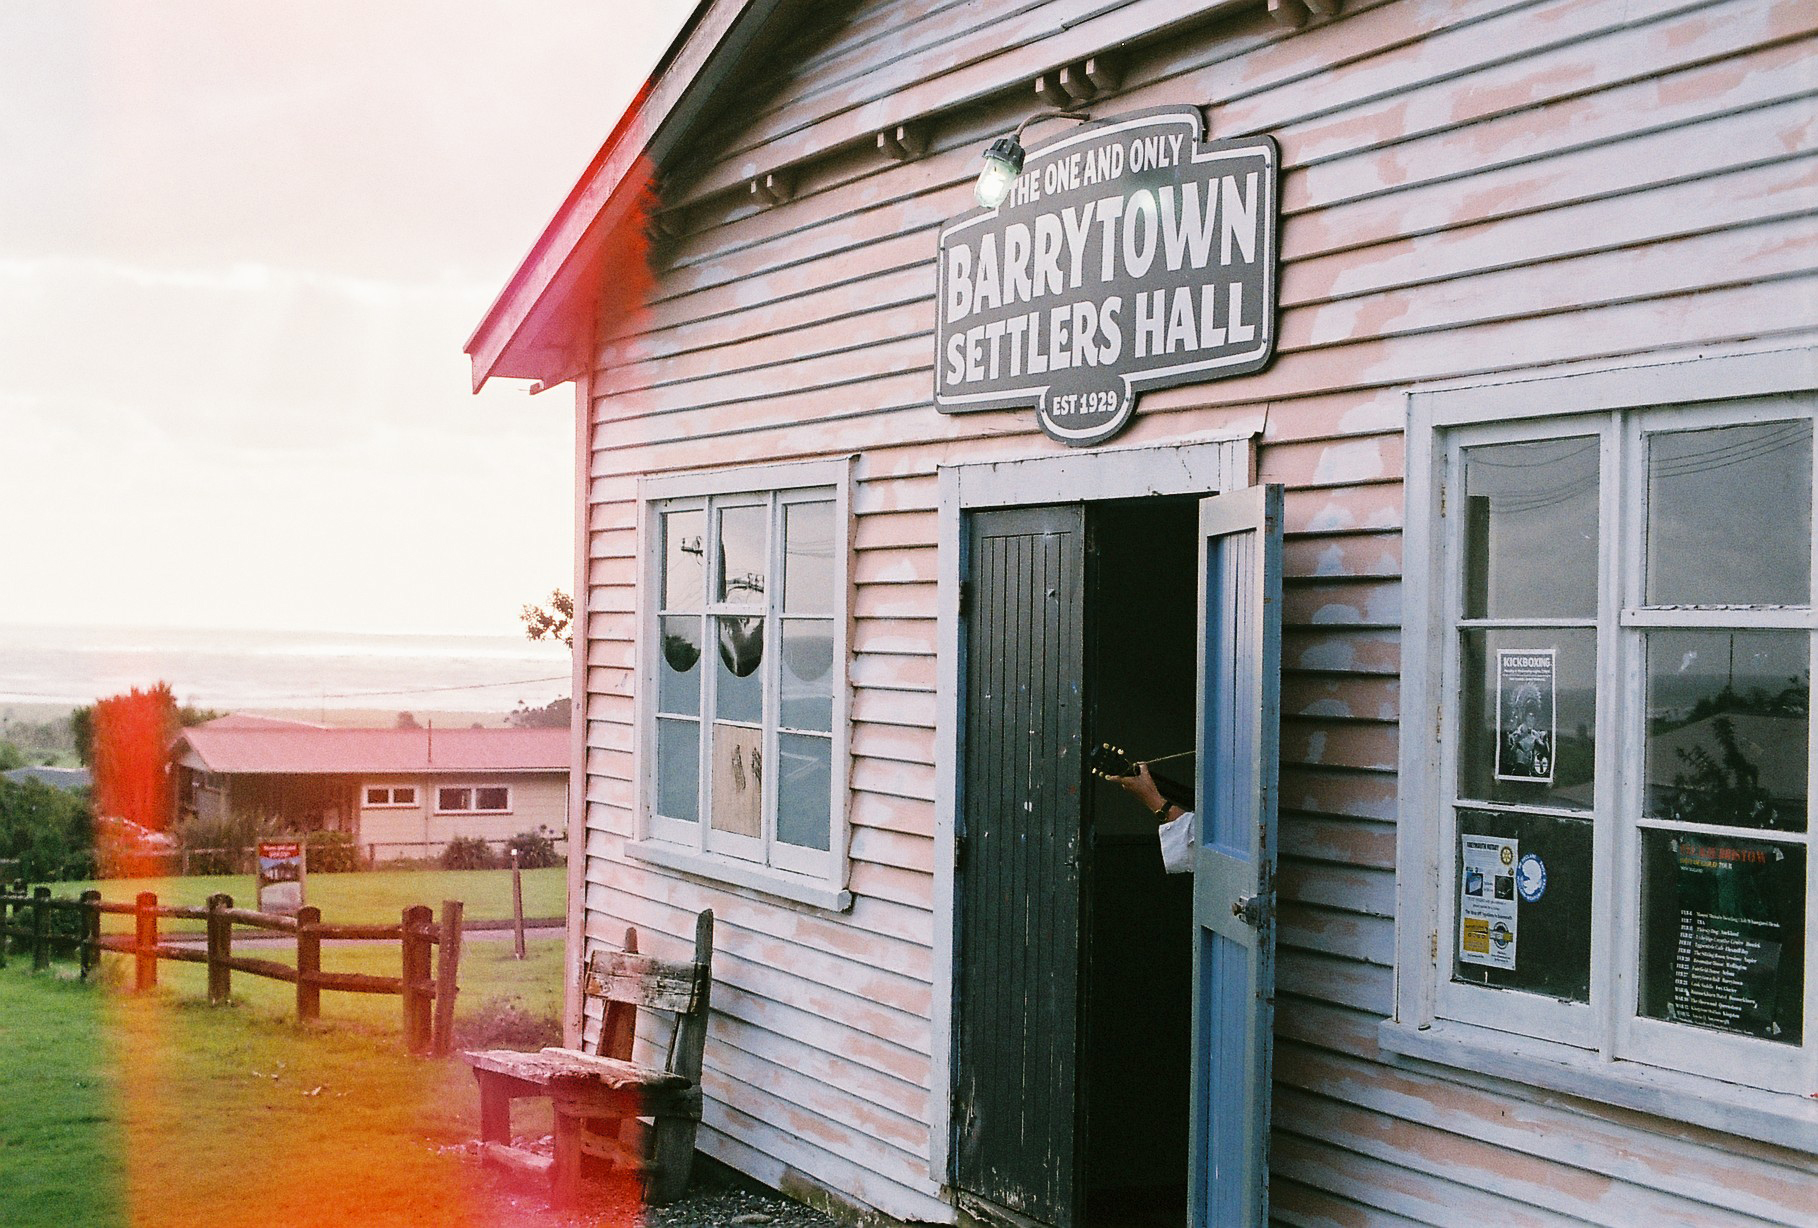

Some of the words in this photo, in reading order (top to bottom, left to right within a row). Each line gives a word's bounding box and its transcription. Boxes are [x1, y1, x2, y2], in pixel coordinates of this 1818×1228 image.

[1009, 175, 1041, 208] THE
[1044, 159, 1080, 196] ONE
[1083, 143, 1125, 186] AND
[1129, 134, 1184, 174] ONLY
[947, 172, 1259, 324] BARRYTOWN
[946, 295, 1123, 386] SETTLERS
[1134, 282, 1256, 359] HALL
[1052, 394, 1077, 416] EST
[1079, 390, 1118, 414] 1929
[1503, 656, 1551, 668] KICKBOXING
